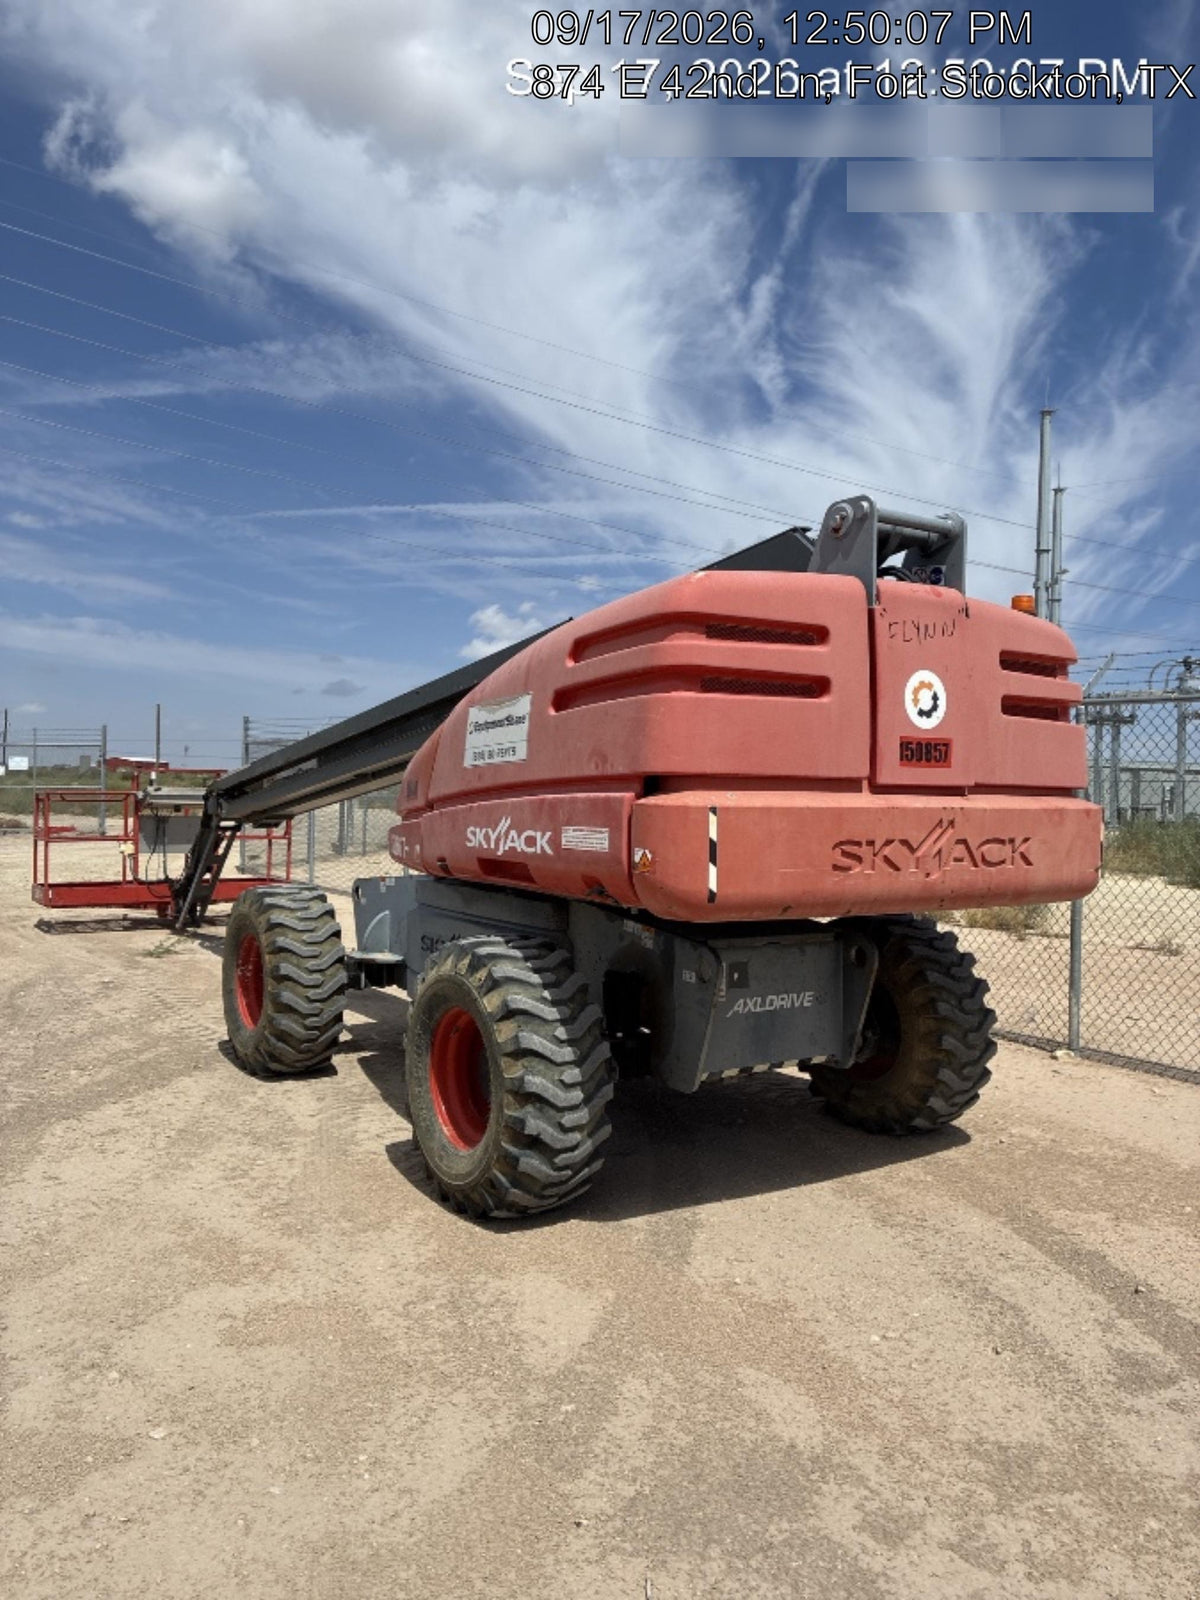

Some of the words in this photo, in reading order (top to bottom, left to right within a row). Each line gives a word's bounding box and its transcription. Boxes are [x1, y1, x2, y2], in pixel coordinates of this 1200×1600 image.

[465, 816, 553, 855] SKYJACK
[832, 818, 1034, 879] SKYJACK
[726, 991, 815, 1018] AXLDRIVE
